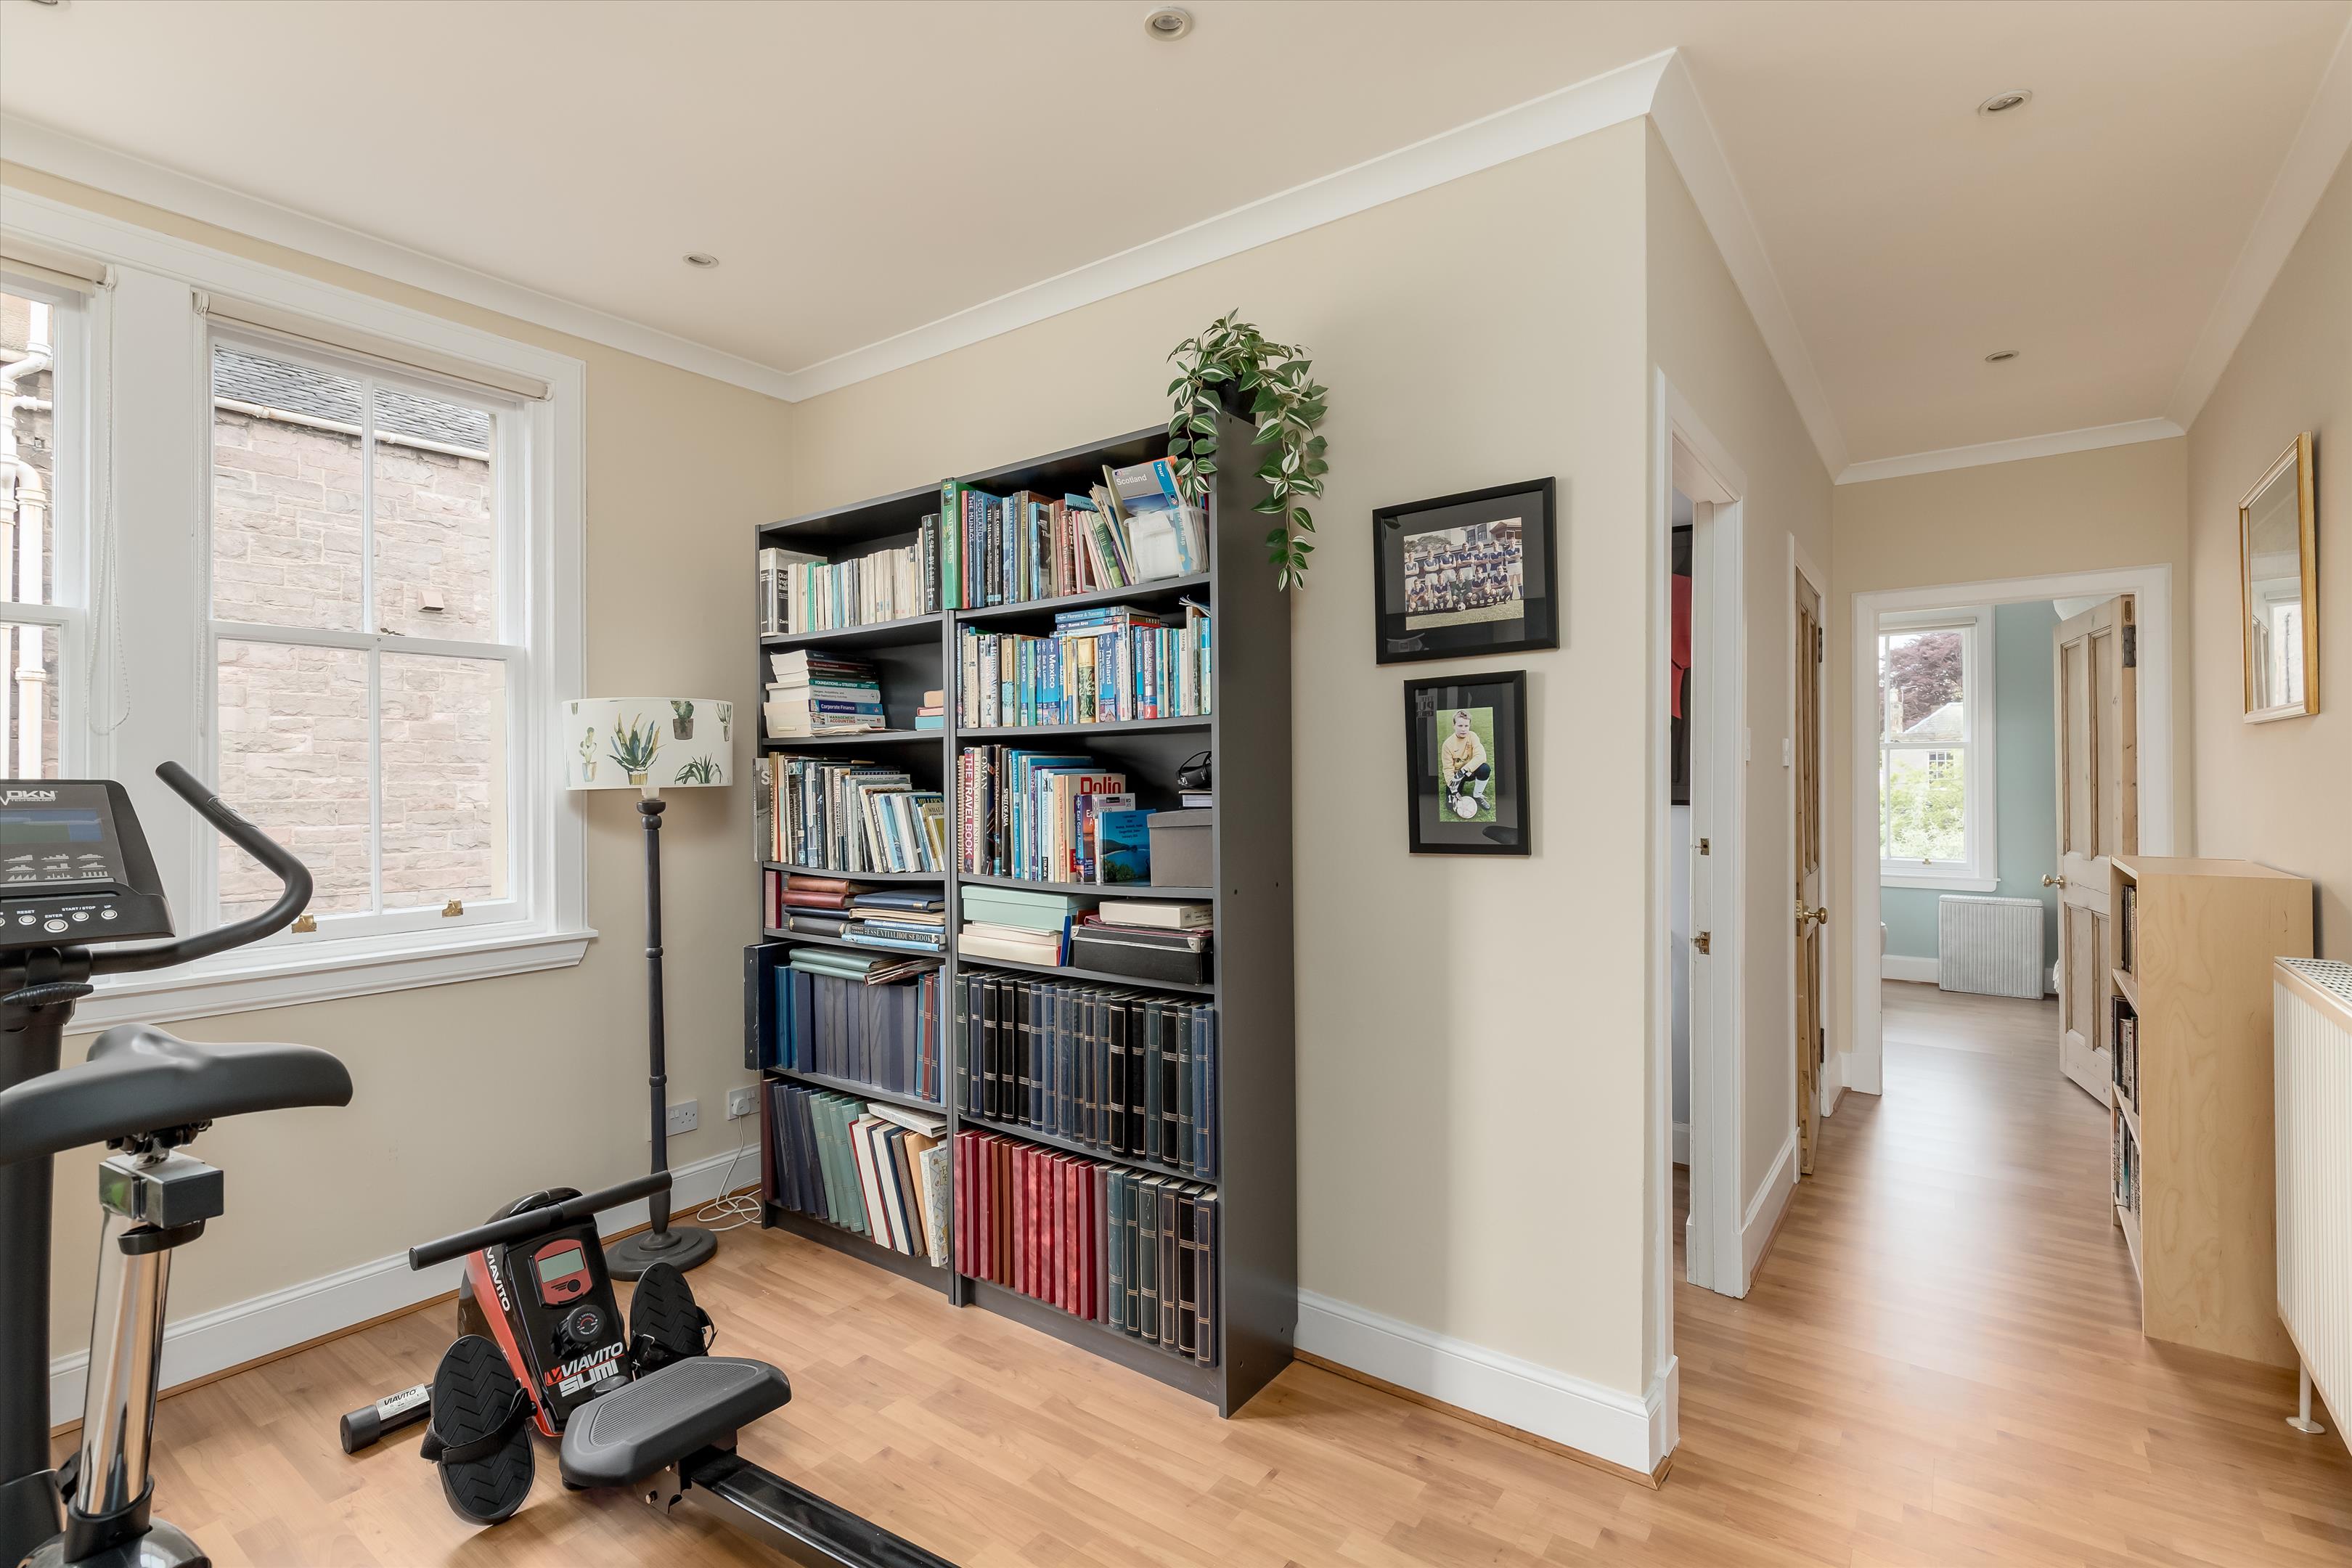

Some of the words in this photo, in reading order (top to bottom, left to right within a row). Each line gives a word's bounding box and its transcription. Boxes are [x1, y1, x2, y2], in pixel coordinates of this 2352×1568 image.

[1116, 474, 1147, 486] Scotland
[486, 1247, 510, 1311] VIAVITO
[561, 1342, 623, 1377] VIAVITO
[558, 1359, 618, 1397] SUMI
[383, 1389, 416, 1405] VIAVITO
